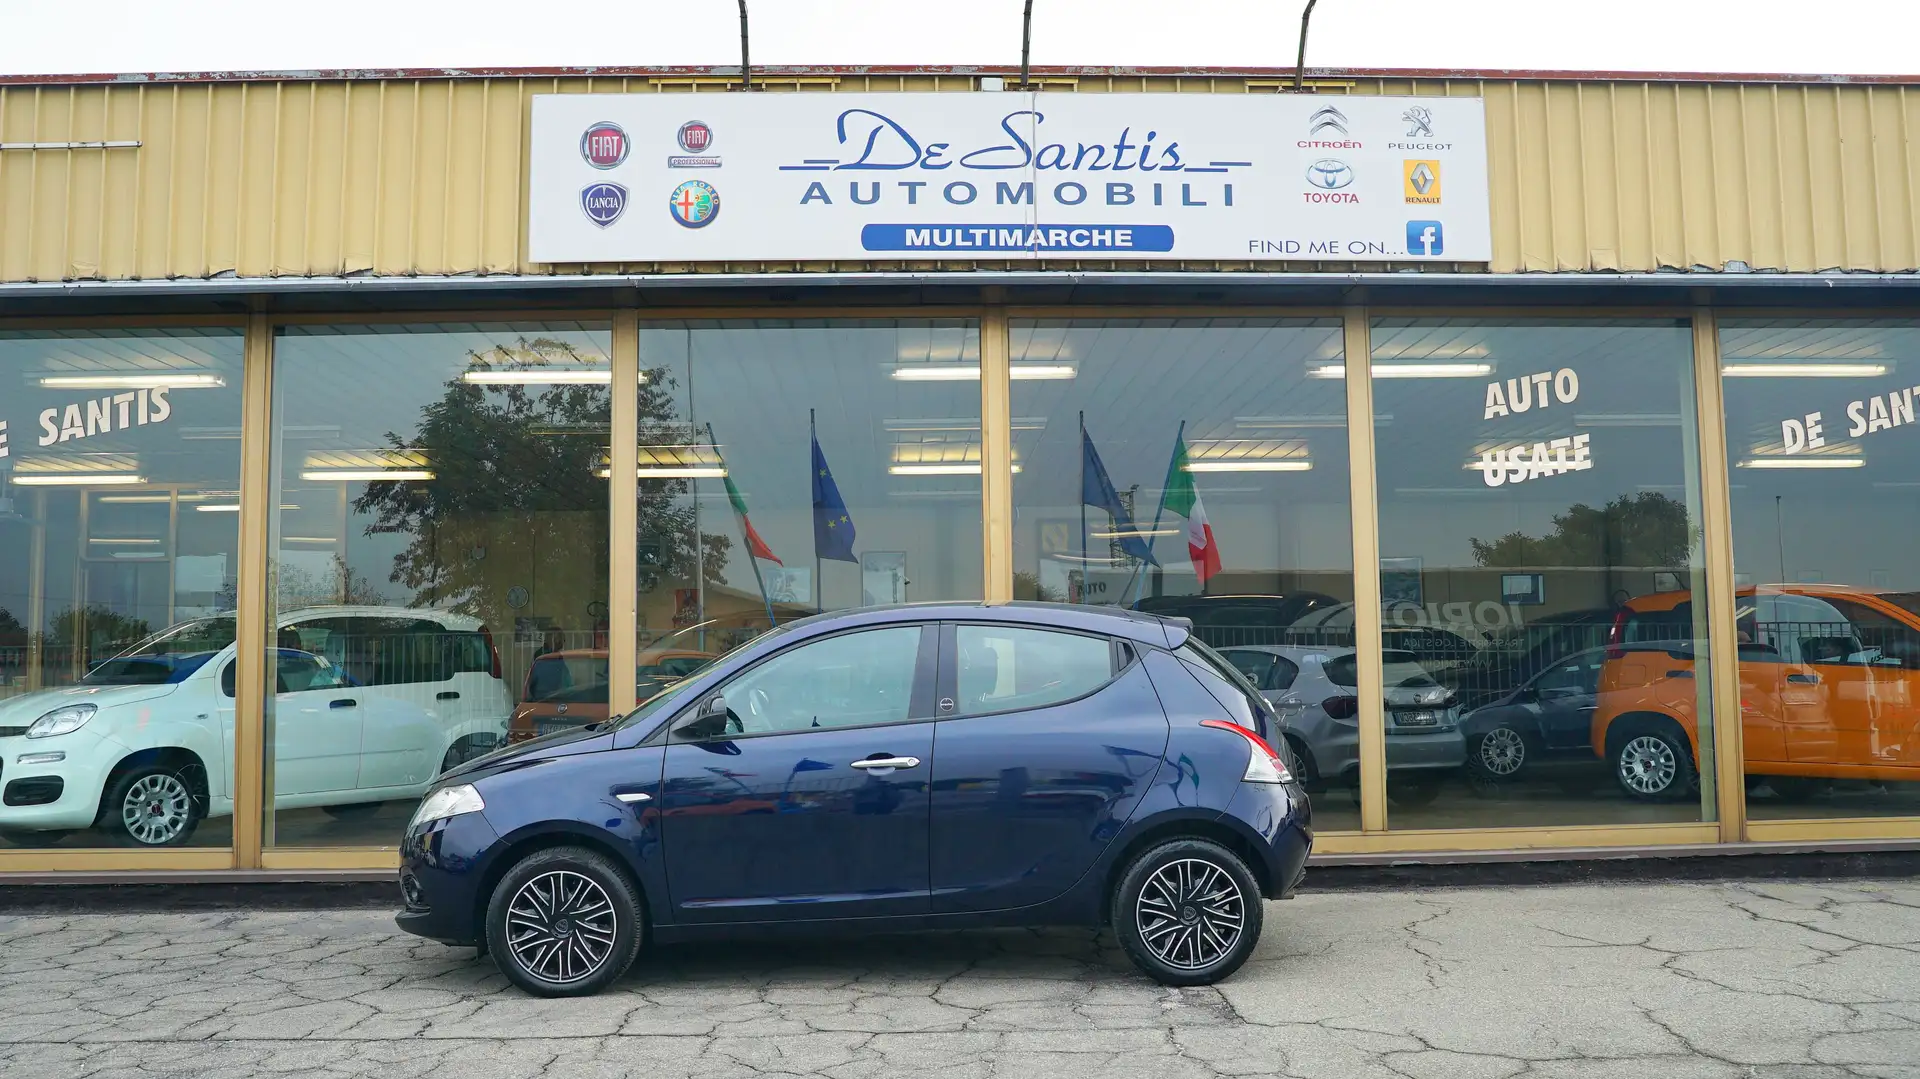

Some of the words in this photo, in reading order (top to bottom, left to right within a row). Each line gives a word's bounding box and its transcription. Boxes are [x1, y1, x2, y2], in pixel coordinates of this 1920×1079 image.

[591, 136, 620, 157] FIAT
[687, 130, 706, 145] FIAT
[833, 108, 953, 172] De
[960, 109, 1187, 172] Santis
[1297, 139, 1363, 149] CITROËN
[1388, 142, 1453, 151] PEUGEOT
[693, 180, 720, 205] ROMEO
[800, 181, 1234, 207] AUTOMOBILI
[1303, 192, 1360, 204] TOYOTA
[1405, 196, 1441, 204] RENAULT
[590, 197, 619, 209] LANCIA
[904, 228, 1133, 248] MULTIMARCHE
[1249, 240, 1301, 254] FIND
[1309, 240, 1340, 254] ME
[1484, 367, 1580, 420] AUTO
[38, 384, 172, 447] SANTIS
[1780, 411, 1826, 456] DE
[1482, 433, 1593, 487] USATE
